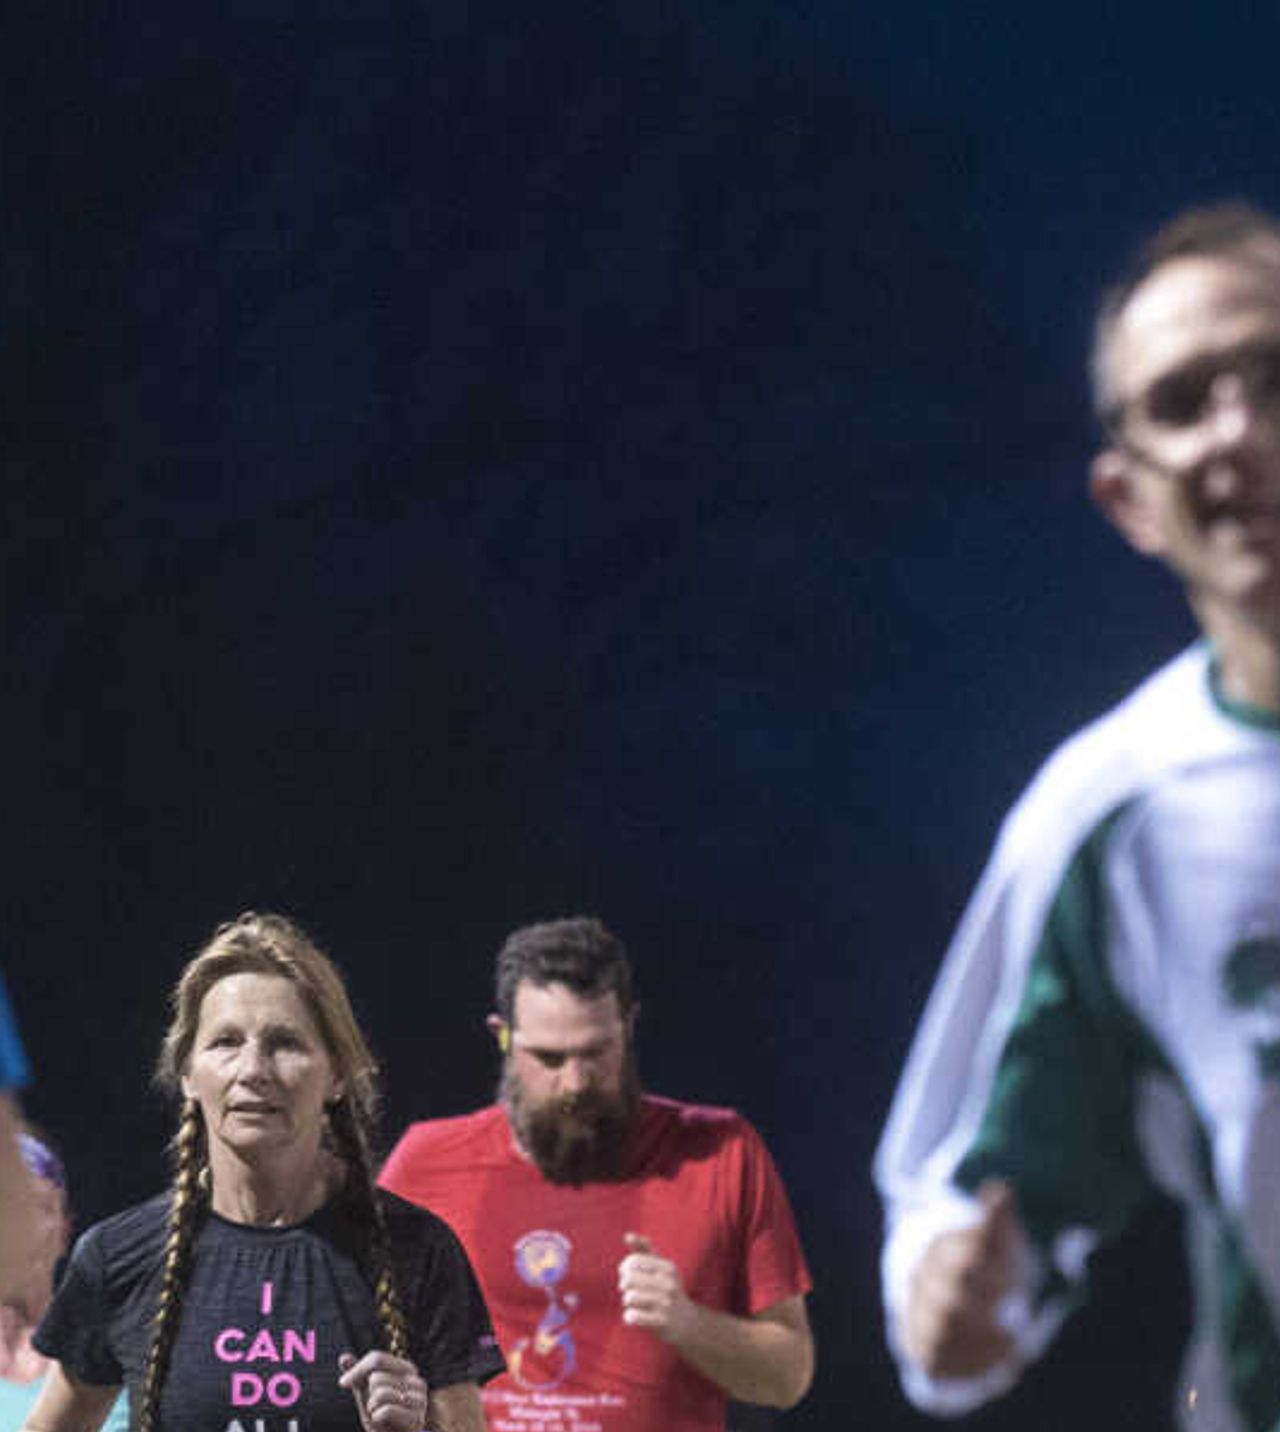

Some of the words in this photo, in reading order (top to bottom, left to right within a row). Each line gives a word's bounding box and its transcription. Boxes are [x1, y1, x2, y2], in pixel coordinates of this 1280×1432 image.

[261, 1281, 273, 1315] I
[214, 1329, 315, 1362] CAN
[231, 1372, 301, 1407] DO
